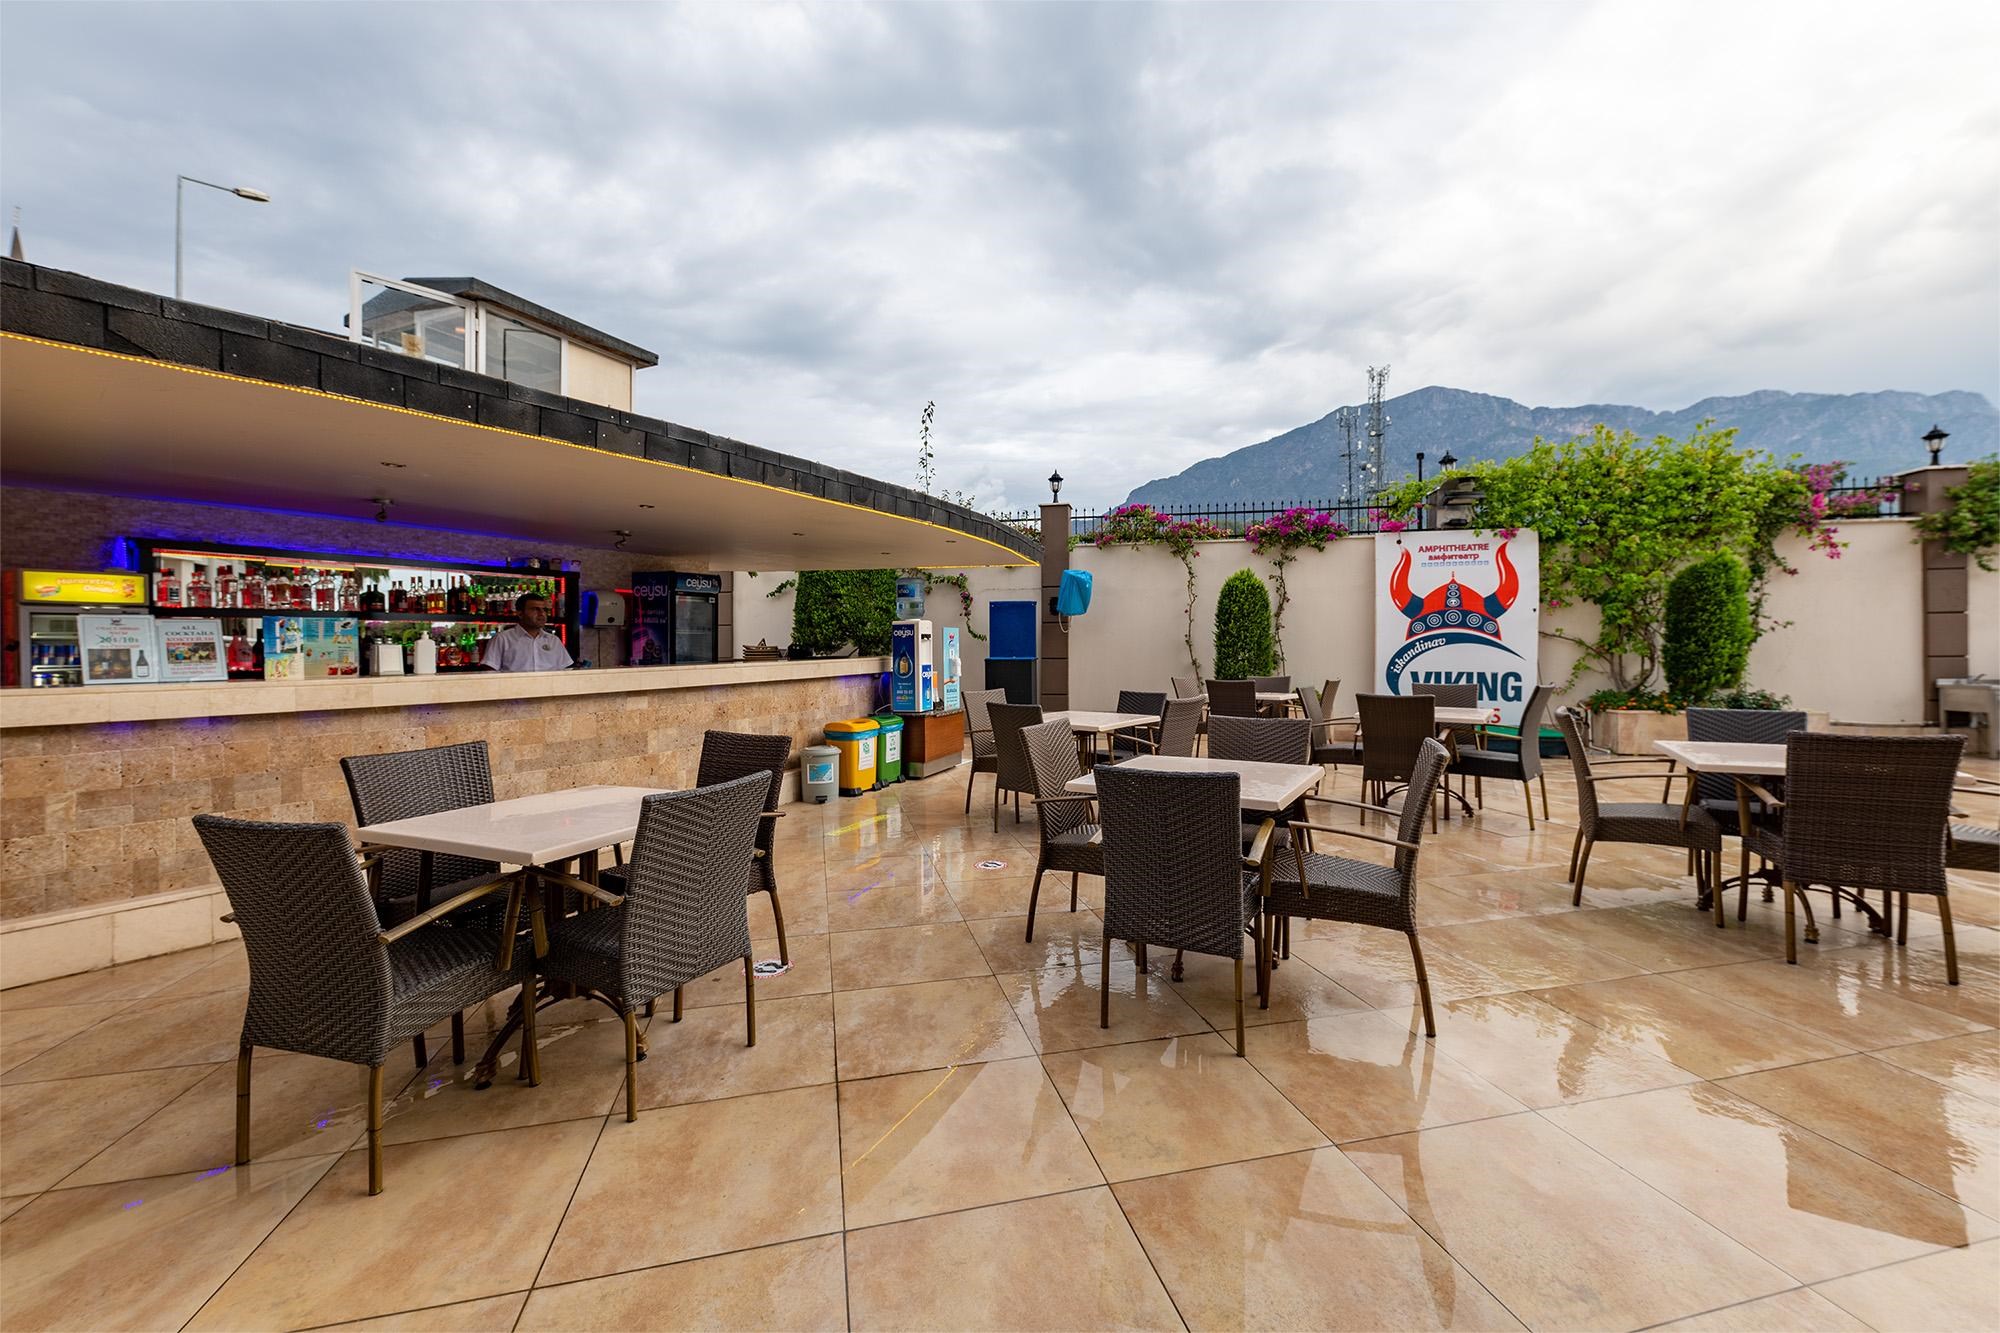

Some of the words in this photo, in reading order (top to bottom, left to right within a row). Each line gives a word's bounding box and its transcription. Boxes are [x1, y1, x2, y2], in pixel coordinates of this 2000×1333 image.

[1418, 543, 1489, 553] AMPHITHEATRE
[1428, 553, 1480, 562] амфитеатр
[686, 577, 712, 590] ceysu
[633, 584, 668, 601] ceysu
[893, 629, 914, 638] ceysu
[1390, 637, 1447, 674] iskandinav
